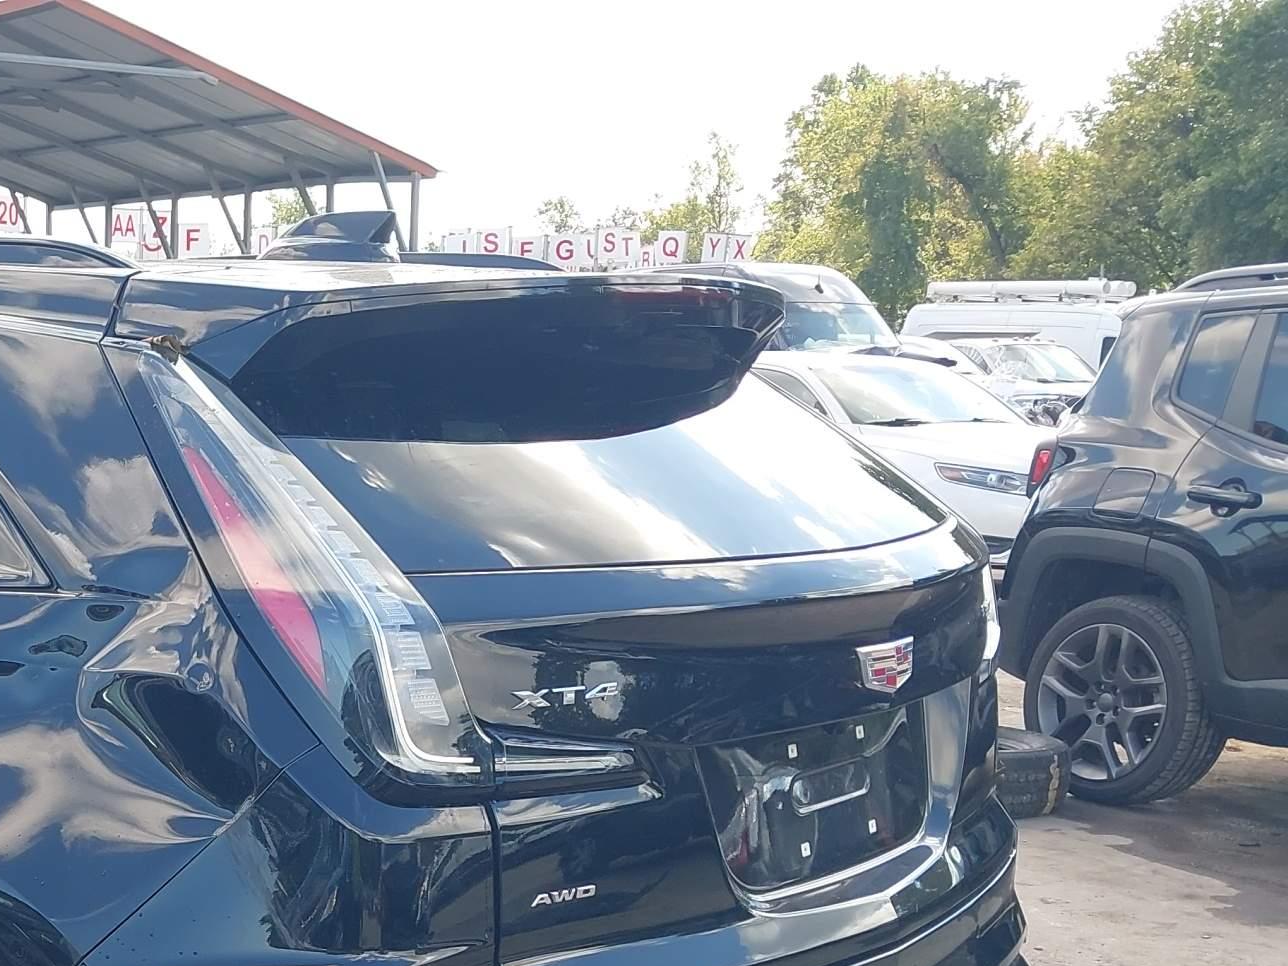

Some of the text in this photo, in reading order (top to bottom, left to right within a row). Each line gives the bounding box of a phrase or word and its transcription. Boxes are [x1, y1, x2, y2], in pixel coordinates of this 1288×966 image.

[112, 214, 136, 237] AA
[186, 229, 200, 250] F
[484, 233, 499, 253] S
[556, 240, 574, 260] G
[604, 232, 616, 253] S
[622, 237, 633, 256] T
[663, 236, 679, 258] Q
[709, 237, 721, 258] Y
[733, 239, 746, 260] X
[511, 682, 618, 710] XT4
[531, 885, 597, 908] AWD
